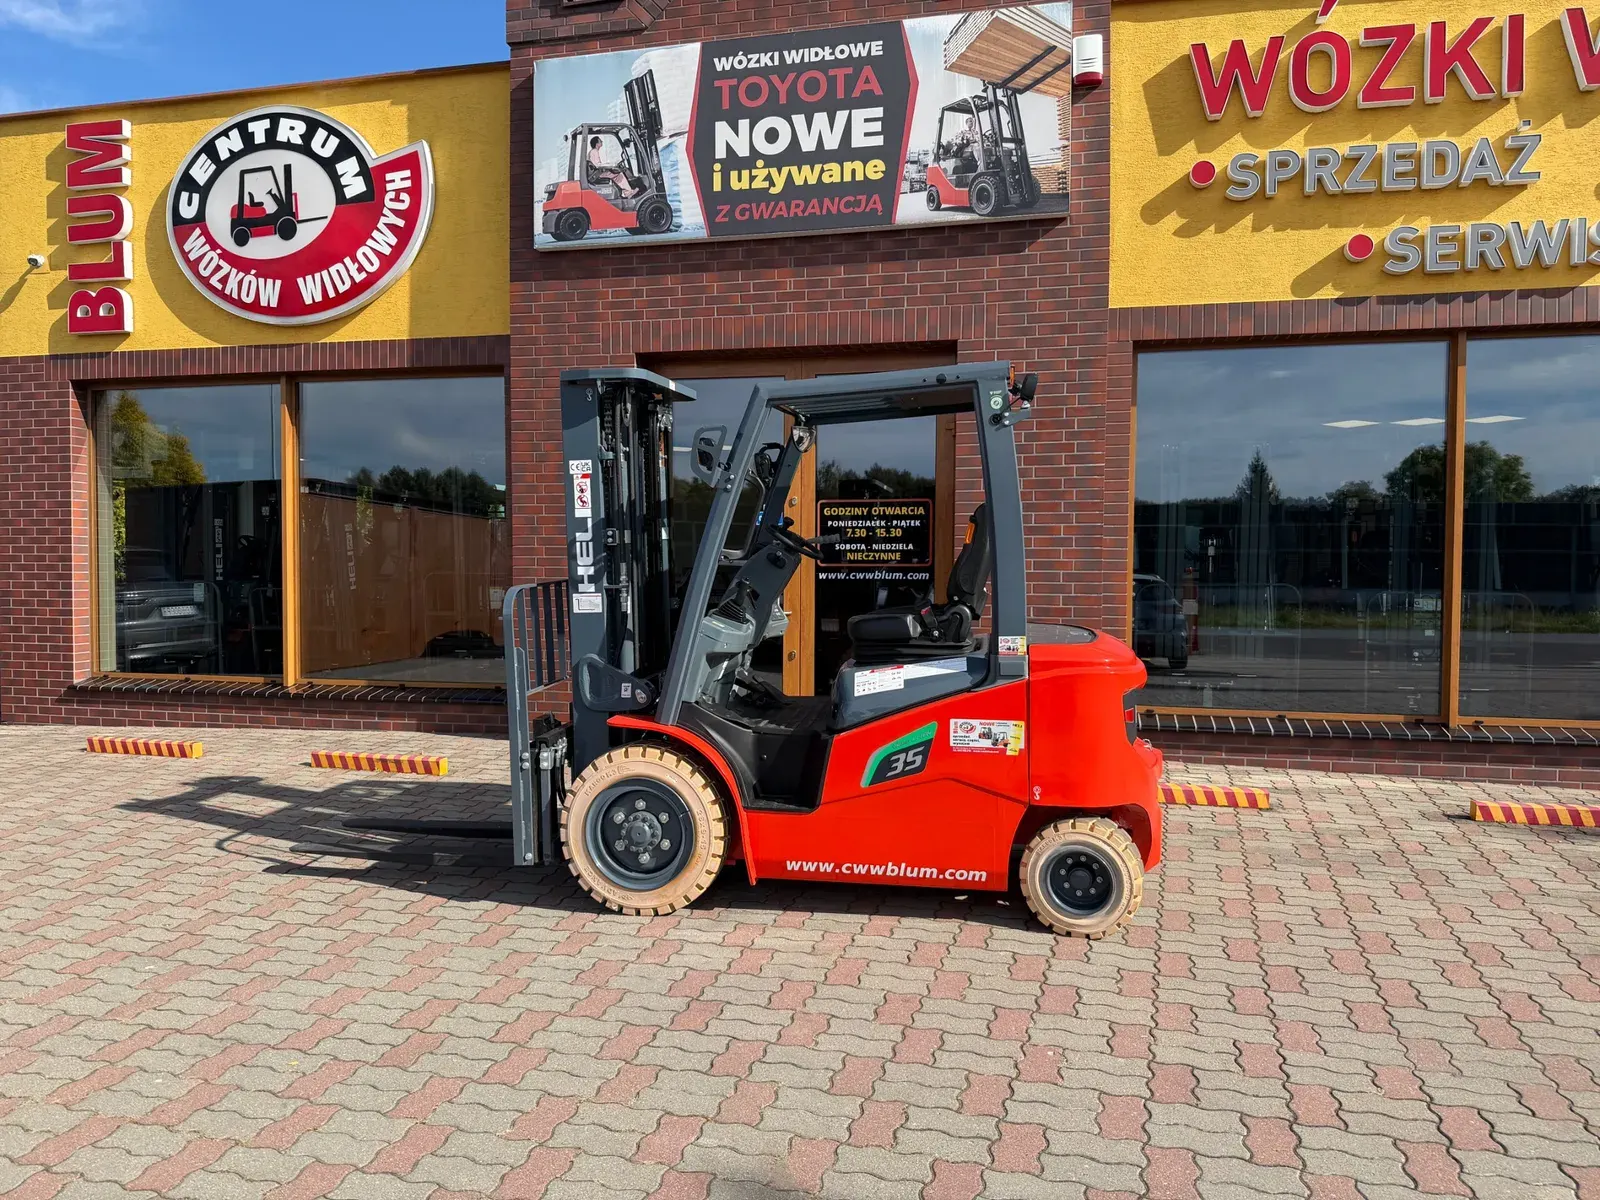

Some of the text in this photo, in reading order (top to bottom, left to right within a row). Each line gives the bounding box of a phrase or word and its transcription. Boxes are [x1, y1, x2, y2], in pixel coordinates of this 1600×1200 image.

[713, 40, 884, 71] WÓZKI WIDŁOWE
[1189, 0, 1525, 121] WÓZKI
[714, 65, 883, 110] TOYOTA
[715, 107, 884, 159] NOWE
[179, 117, 367, 219] CENTRUM
[713, 159, 886, 194] i używane
[1225, 119, 1542, 201] SPRZEDAŻ
[715, 194, 883, 222] Z GWARANCJĄ
[66, 119, 133, 335] BLUM
[183, 169, 412, 308] WÓZKÓW WIDŁOWYCH
[823, 506, 925, 516] GODZINY OTWARCIA
[892, 520, 921, 528] PIĄTEK
[846, 528, 867, 537] 7.30
[875, 528, 902, 537] 15.30
[575, 508, 595, 592] HELI
[846, 552, 901, 560] NIECZYNNE
[818, 571, 930, 580] www.cwwblum.com
[885, 746, 925, 777] 35
[785, 860, 988, 882] www.cwwblum.com
